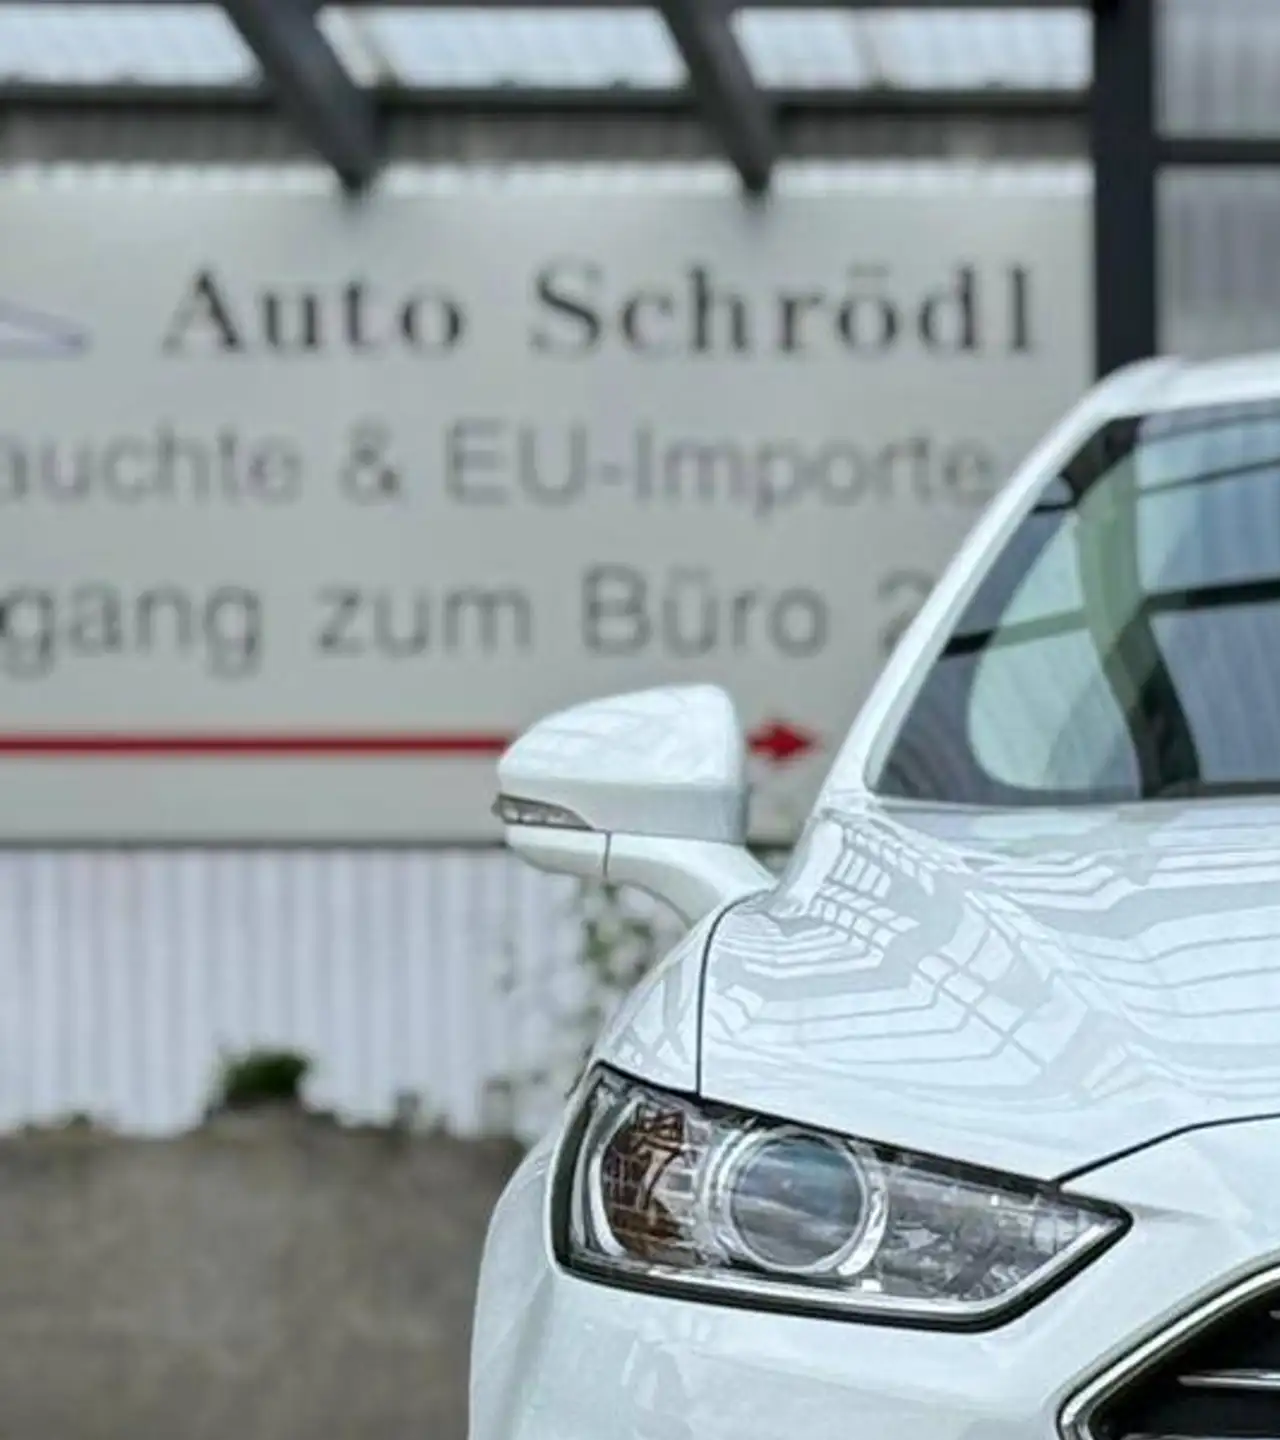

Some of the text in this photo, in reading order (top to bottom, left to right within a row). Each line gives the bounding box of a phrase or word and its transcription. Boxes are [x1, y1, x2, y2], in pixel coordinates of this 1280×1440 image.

[160, 262, 1040, 356] Auto Schrödl
[338, 420, 400, 504] &
[444, 418, 996, 514] EU-Importe
[314, 588, 530, 658] zum
[578, 562, 826, 658] Büro
